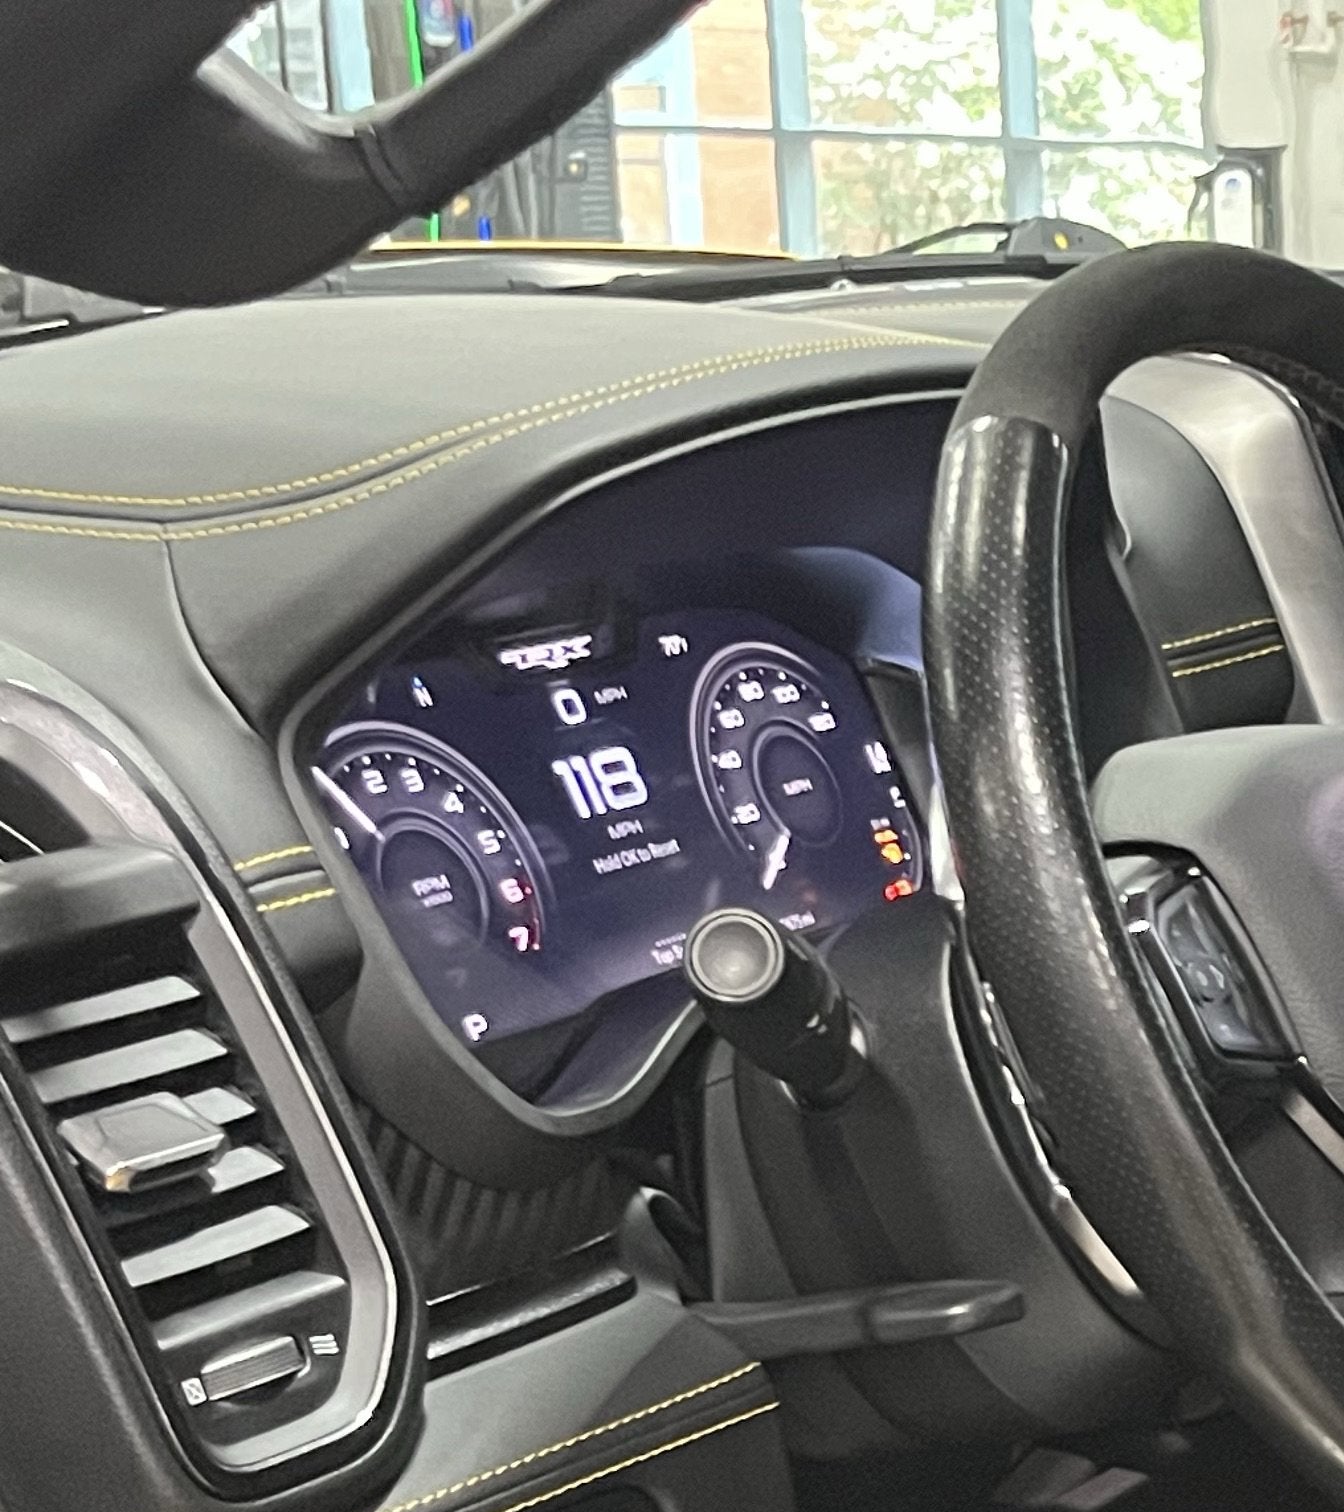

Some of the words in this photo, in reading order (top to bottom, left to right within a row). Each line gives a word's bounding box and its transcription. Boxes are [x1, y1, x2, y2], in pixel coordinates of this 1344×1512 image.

[552, 688, 587, 725] 0
[361, 769, 388, 794] 2
[401, 768, 425, 793] 3
[551, 746, 648, 819] 118
[443, 791, 464, 813] 4
[477, 829, 501, 854] 5
[620, 848, 641, 867] OK
[412, 874, 451, 898] RPM
[500, 878, 524, 903] 6
[508, 926, 530, 952] 7
[462, 1013, 488, 1041] P
